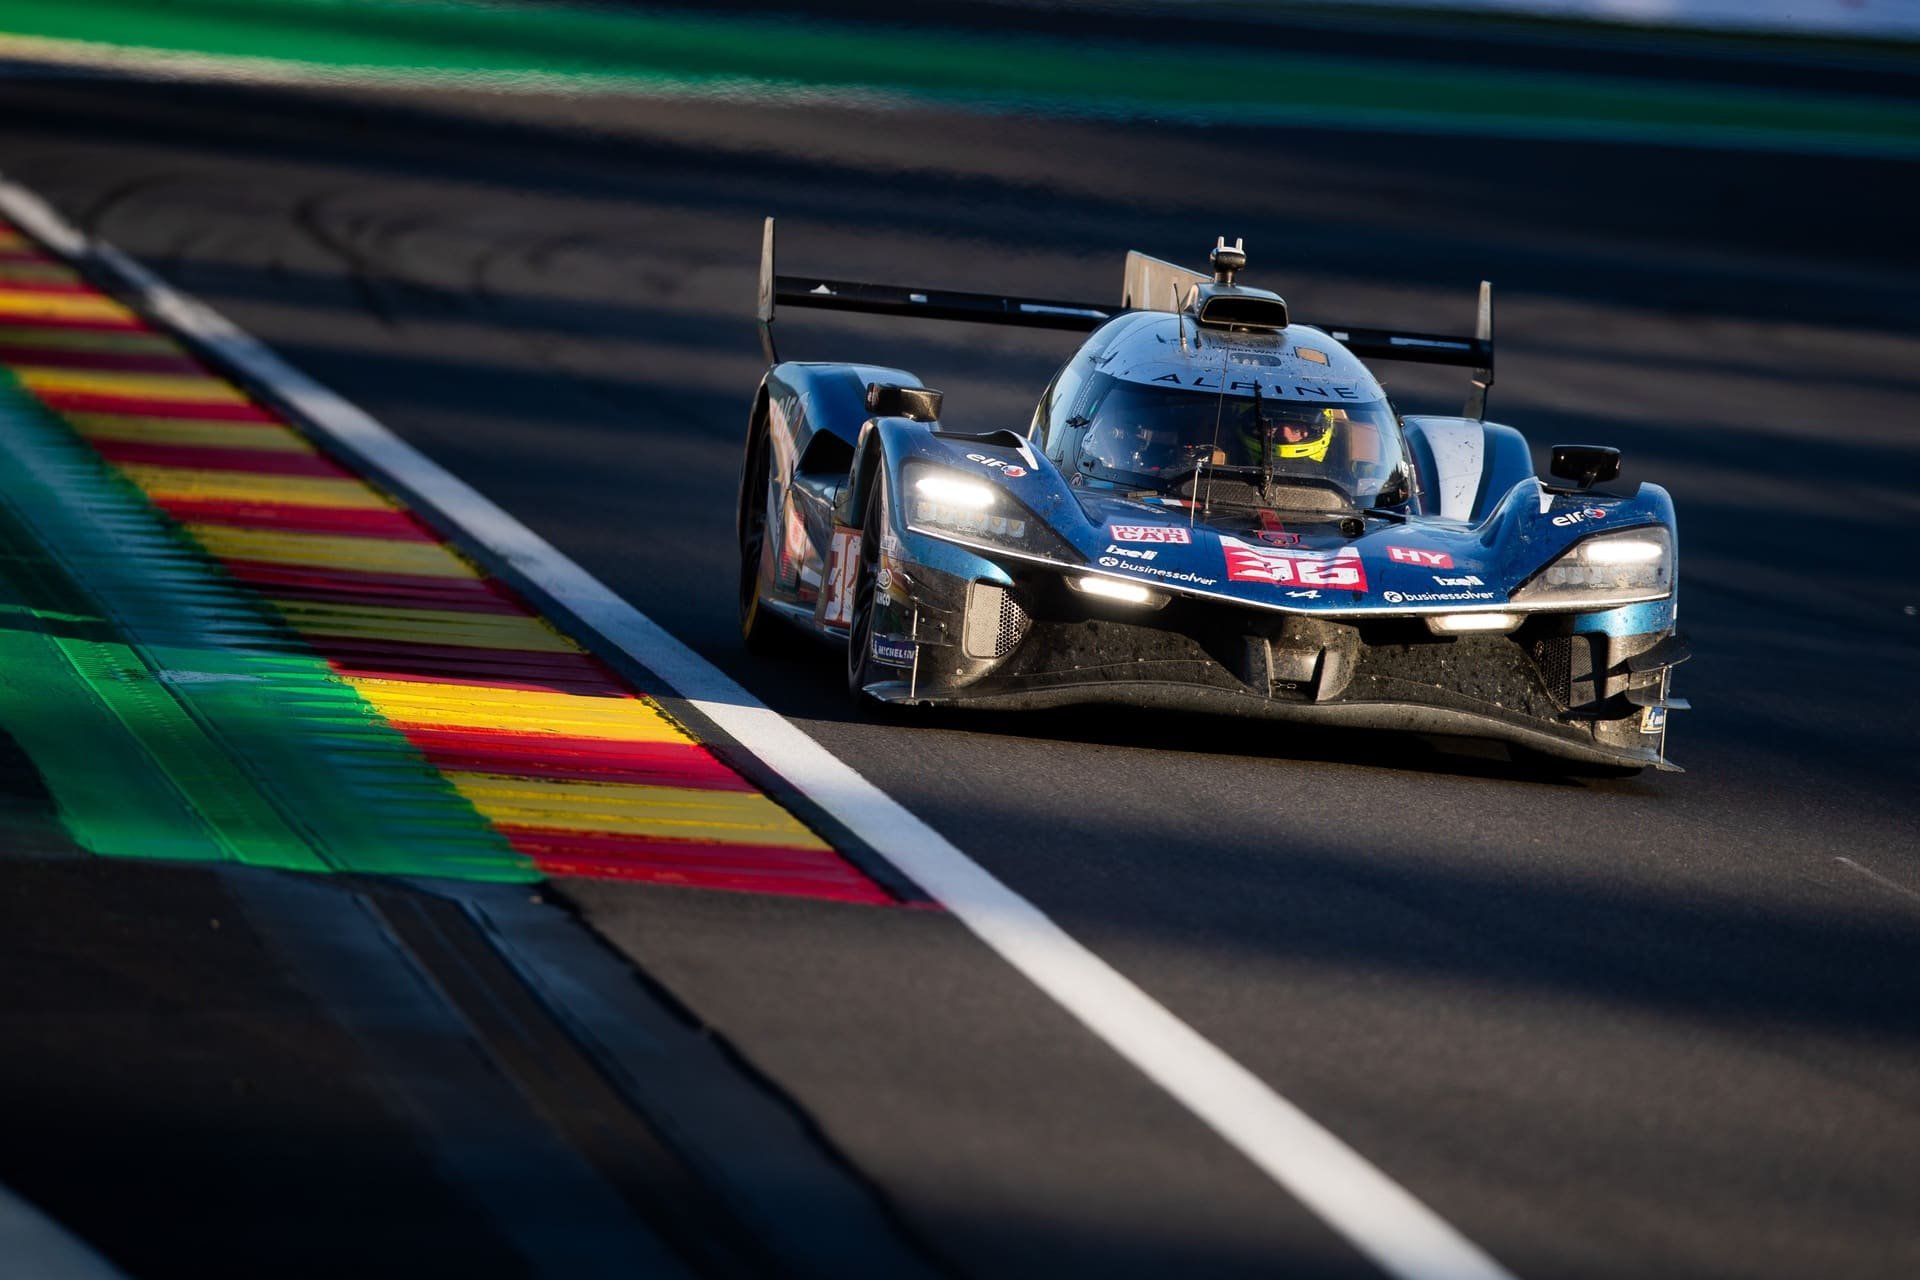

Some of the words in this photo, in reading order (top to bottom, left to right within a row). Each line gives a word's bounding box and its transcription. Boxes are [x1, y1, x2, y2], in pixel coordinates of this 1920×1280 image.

[1152, 373, 1359, 399] ALPINE
[966, 454, 1009, 467] elf
[1115, 526, 1180, 534] HYPER
[1117, 532, 1184, 542] CAR
[1391, 548, 1447, 564] HY
[1119, 560, 1217, 586] businessolver
[1229, 551, 1360, 585] 36
[1402, 590, 1494, 601] businessolver
[878, 645, 915, 660] MICHELIN
